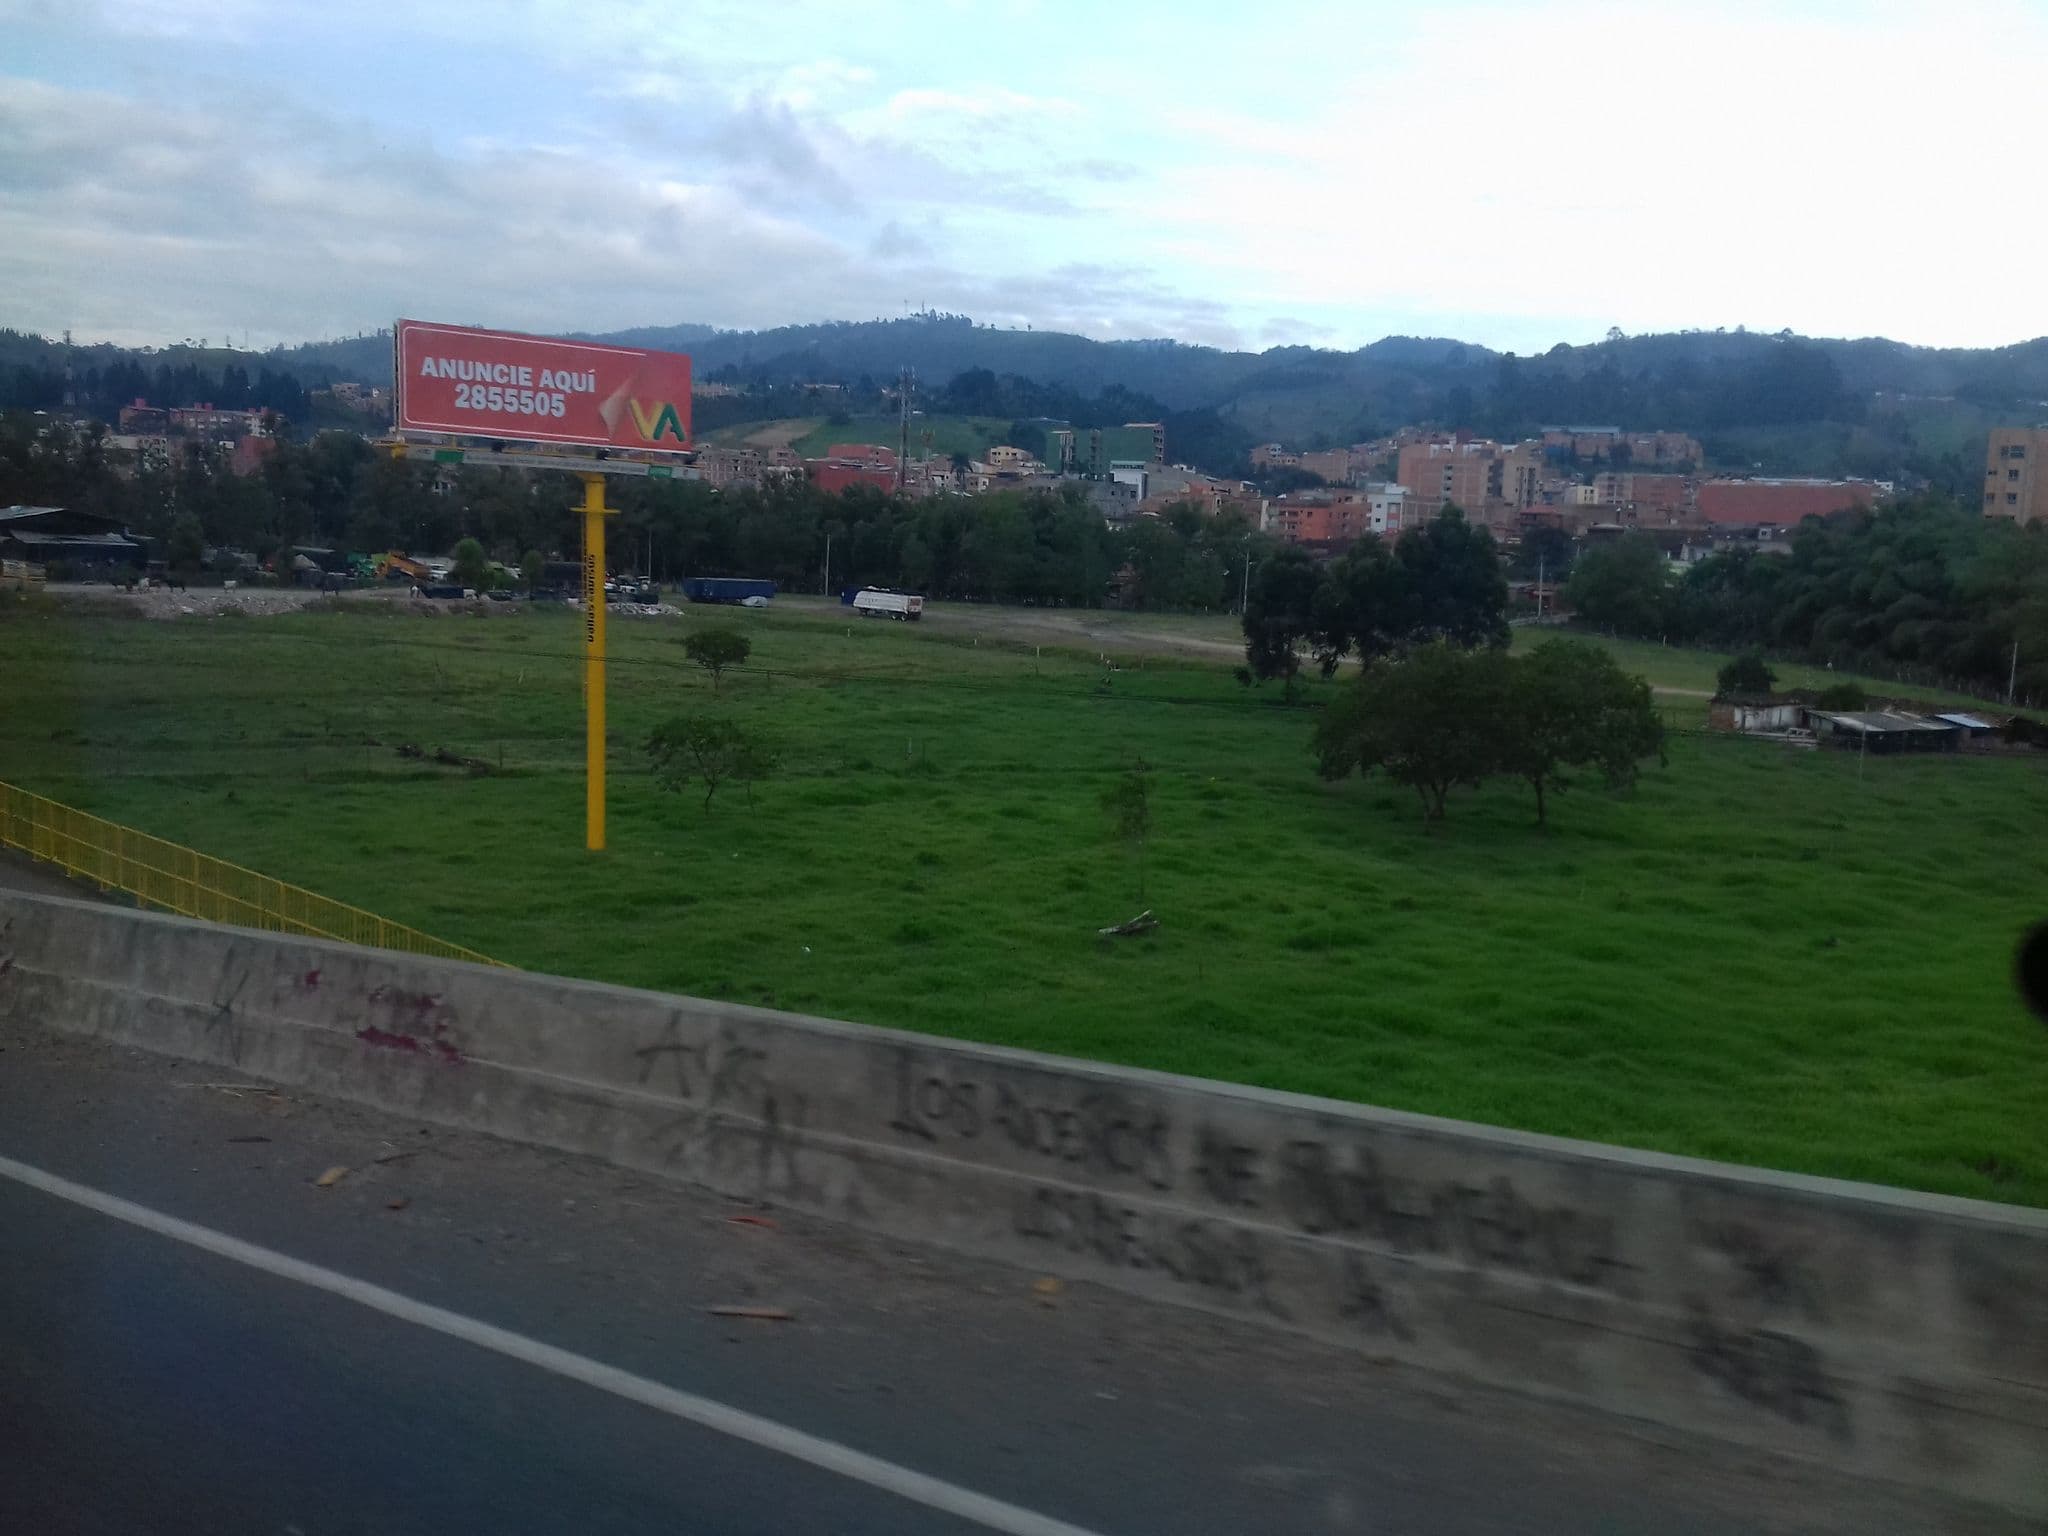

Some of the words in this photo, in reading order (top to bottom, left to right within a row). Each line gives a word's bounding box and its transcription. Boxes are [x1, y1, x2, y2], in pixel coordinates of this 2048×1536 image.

[420, 356, 533, 386] ANUNCIE
[539, 369, 596, 393] AQUÍ
[454, 383, 566, 417] 2855505
